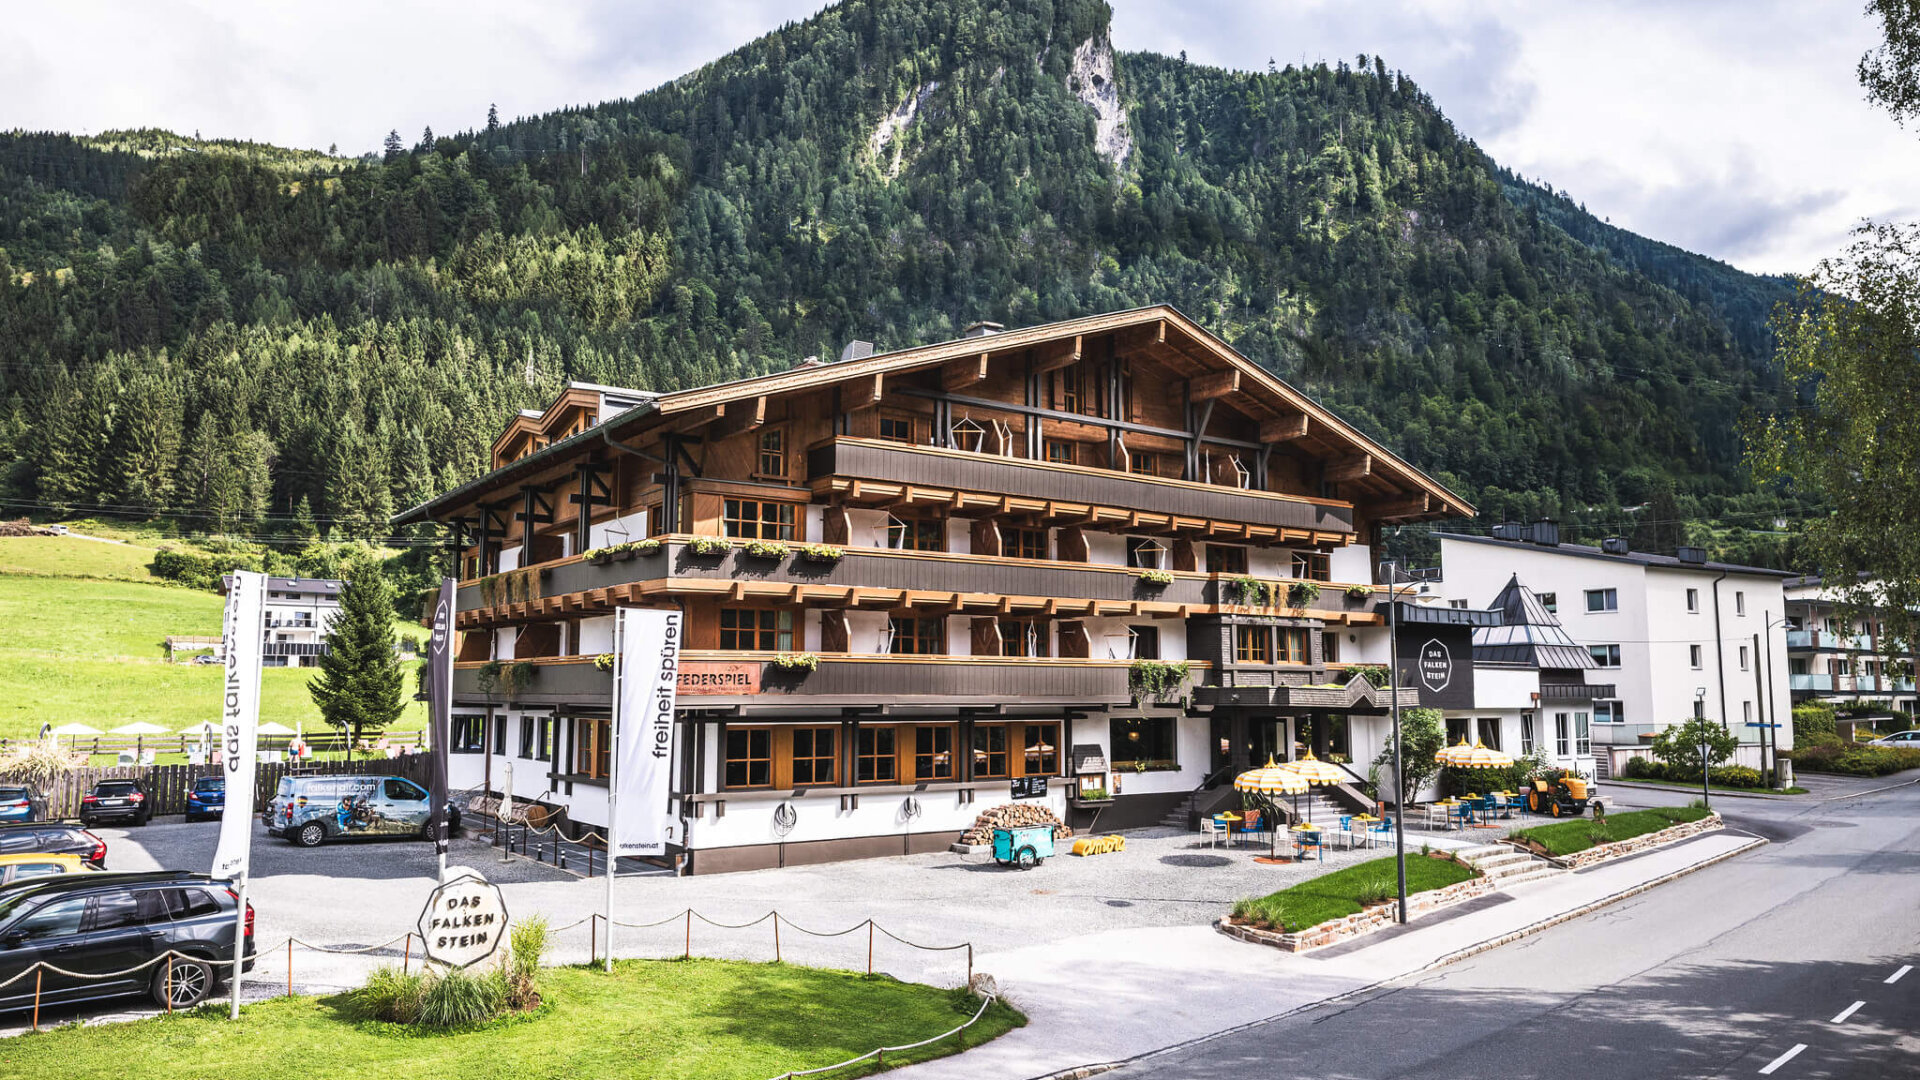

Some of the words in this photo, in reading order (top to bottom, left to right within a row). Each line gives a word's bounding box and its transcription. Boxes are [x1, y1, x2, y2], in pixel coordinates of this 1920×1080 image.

[660, 614, 679, 682] spüren
[1428, 650, 1442, 658] DAS
[1423, 661, 1447, 669] FALKEN
[677, 673, 752, 686] FEDERSPIEL
[1426, 671, 1446, 680] STEIN
[652, 685, 673, 759] freiheit
[447, 895, 481, 910] DAS
[432, 912, 494, 930] FALKEN
[437, 931, 488, 949] STEIN
